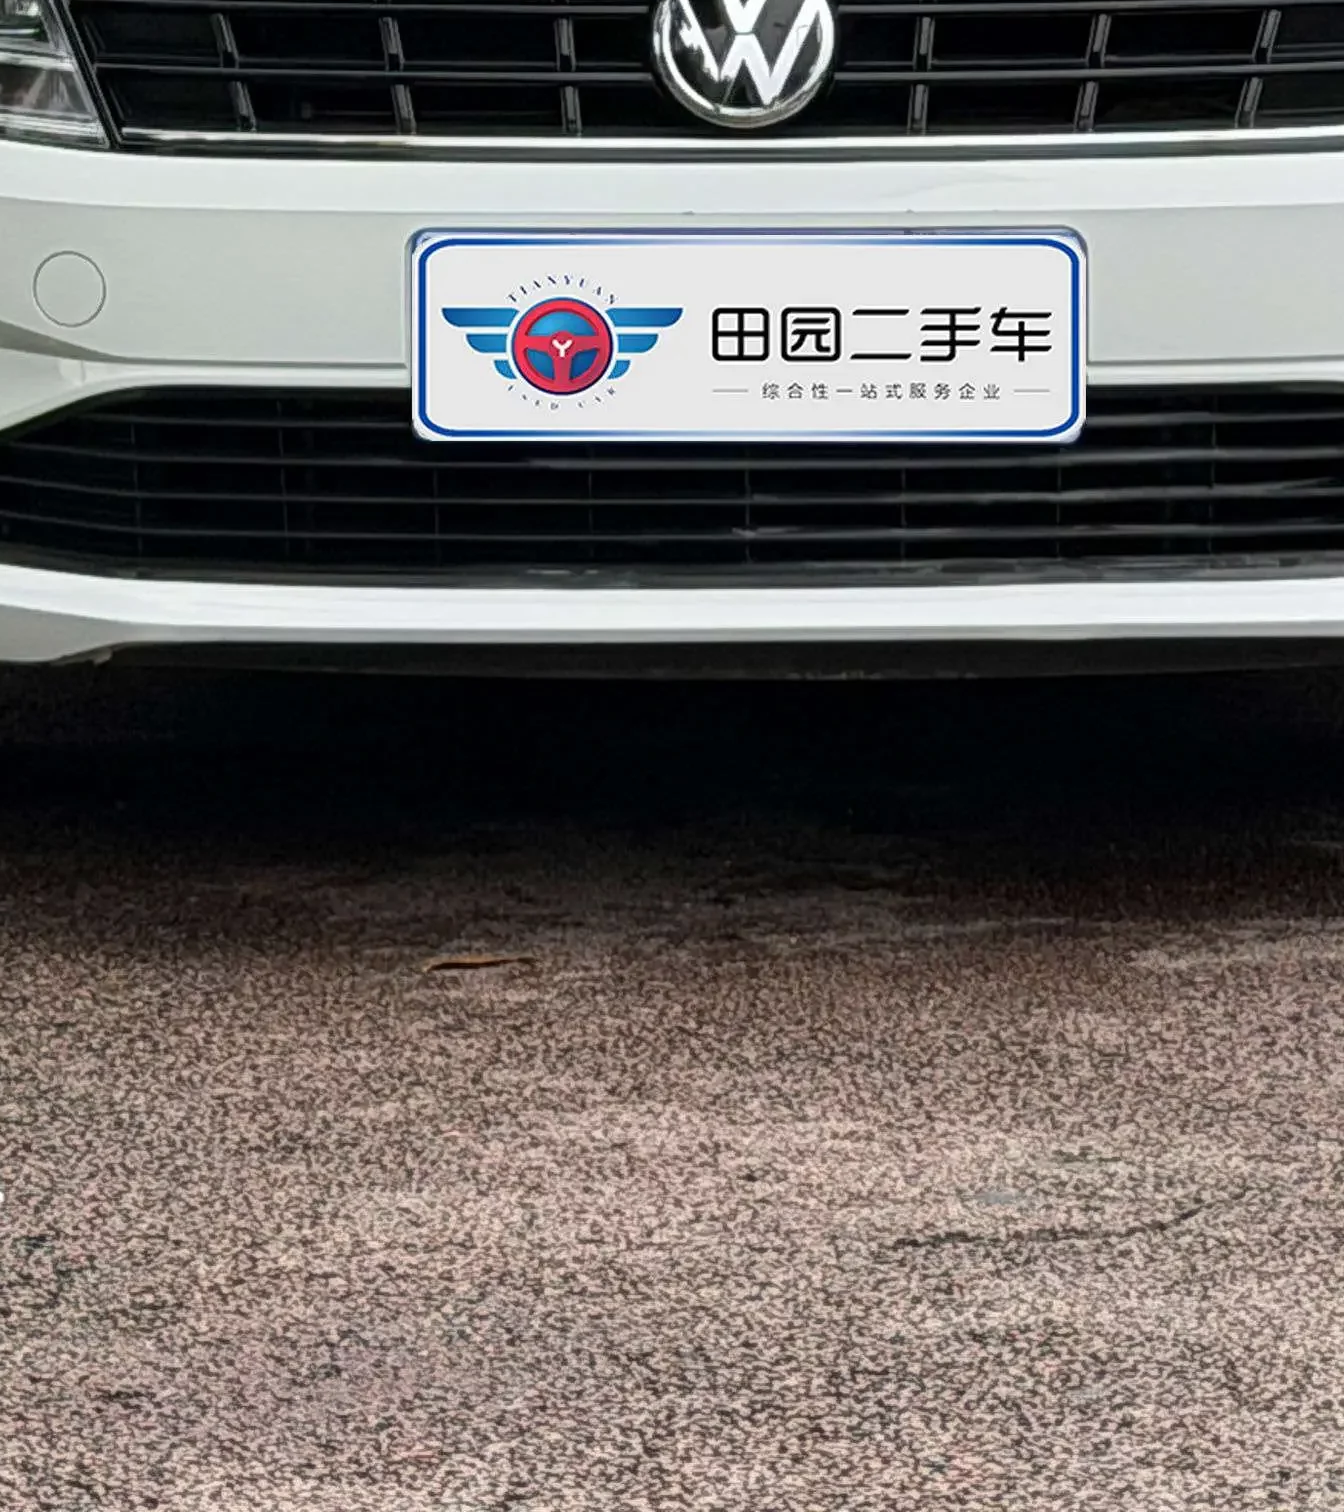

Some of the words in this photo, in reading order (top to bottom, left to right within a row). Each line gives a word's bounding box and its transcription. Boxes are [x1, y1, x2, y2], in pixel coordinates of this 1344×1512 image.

[712, 306, 1053, 362] 田园二手车
[551, 339, 573, 358] Y
[761, 382, 1002, 401] 综合性一站式服务企业
